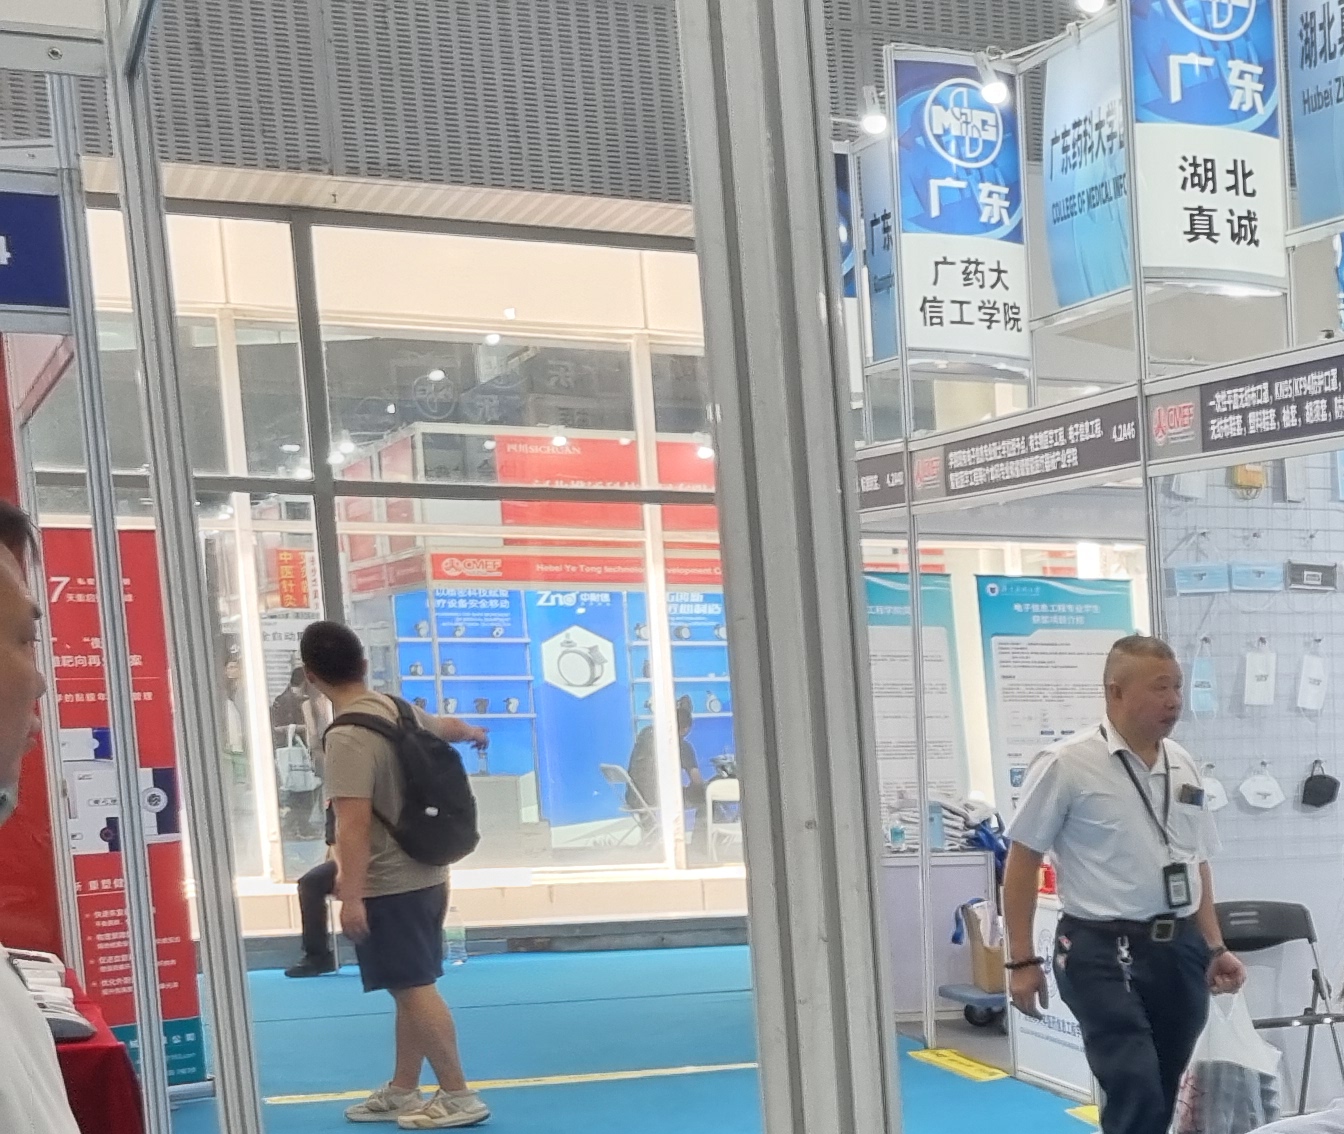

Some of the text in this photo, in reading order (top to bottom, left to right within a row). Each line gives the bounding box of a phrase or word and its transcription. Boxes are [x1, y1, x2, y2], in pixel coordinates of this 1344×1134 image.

[1169, 53, 1265, 115] 广东
[1302, 81, 1334, 116] Hubei
[1178, 155, 1257, 198] 湖北
[929, 177, 1011, 226] 广东
[1051, 198, 1077, 226] COLLEGE
[1077, 191, 1086, 214] OF
[1183, 205, 1260, 248] 真诚
[932, 256, 1010, 291] 广药大
[919, 296, 1023, 332] 信工学院
[1167, 404, 1194, 431] CMEF
[536, 563, 563, 573] Hebei
[579, 564, 602, 576] Tong
[50, 576, 71, 603] 7
